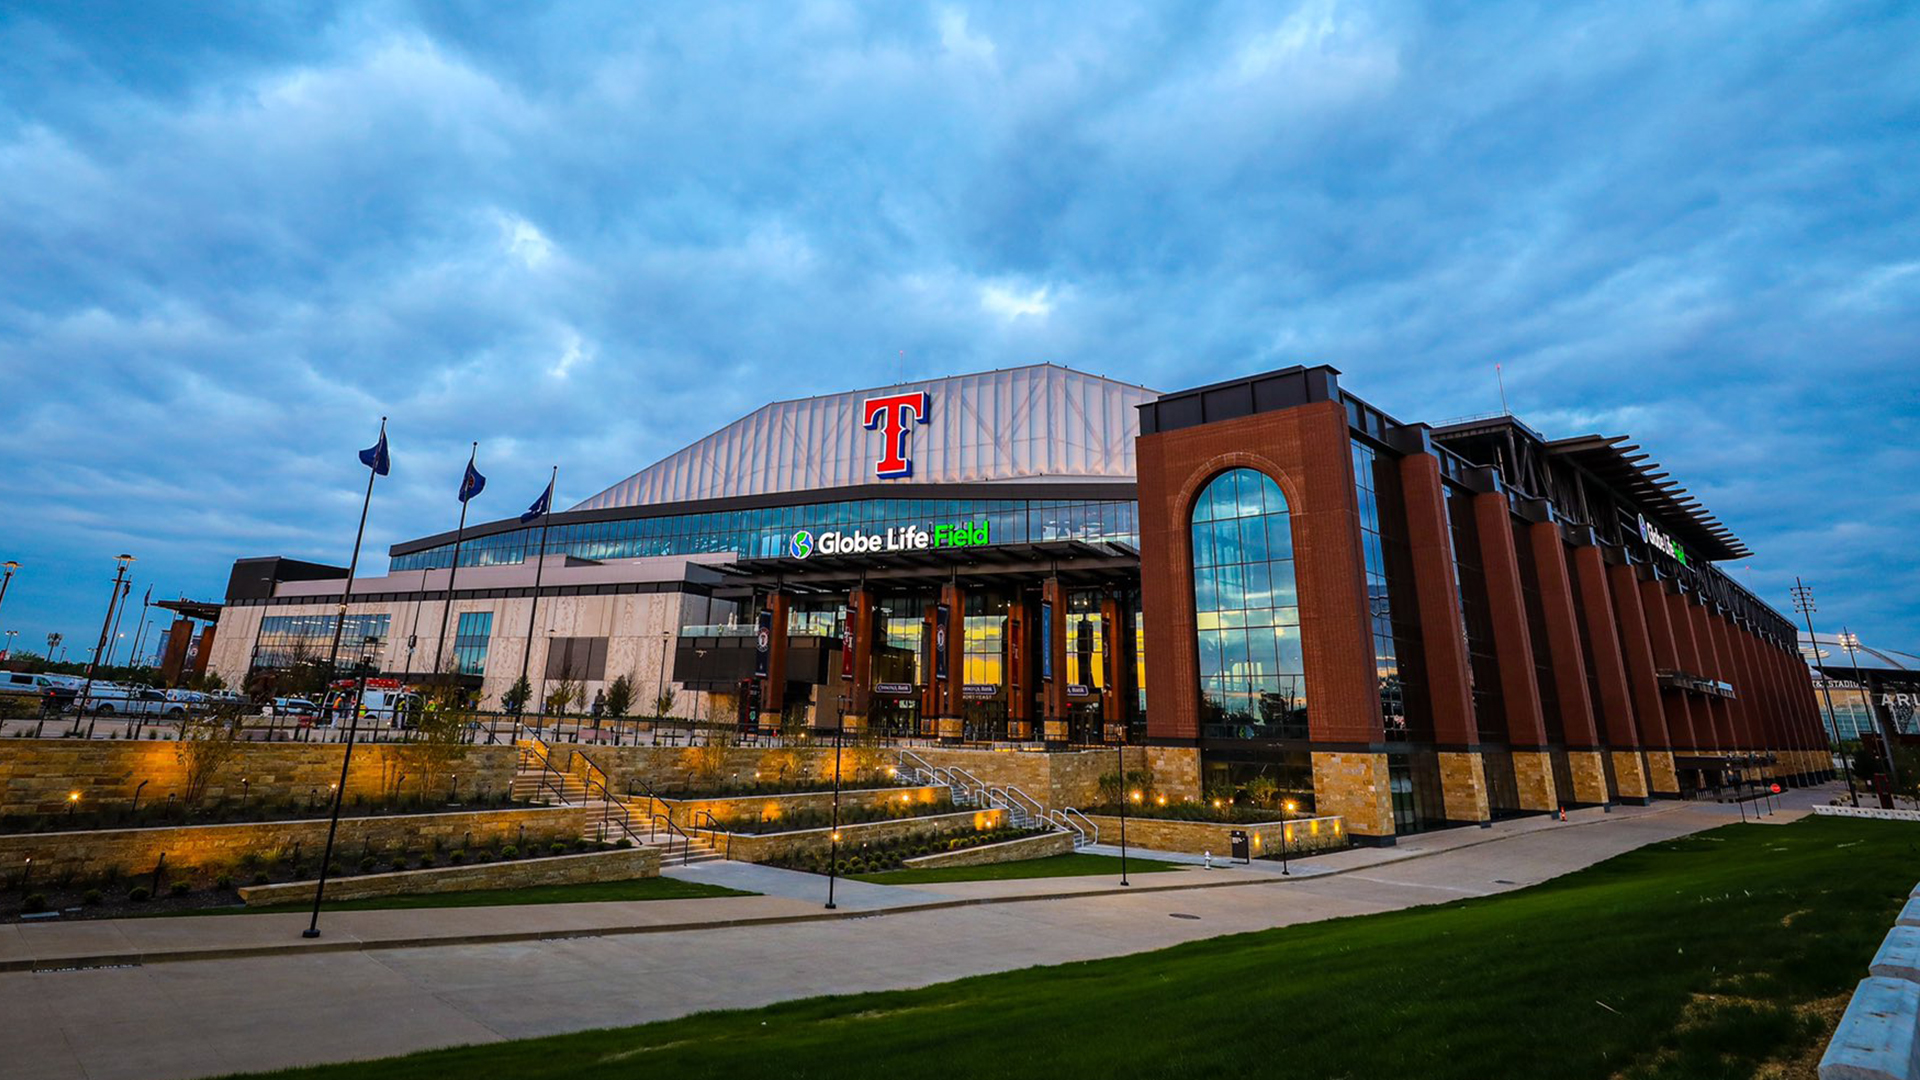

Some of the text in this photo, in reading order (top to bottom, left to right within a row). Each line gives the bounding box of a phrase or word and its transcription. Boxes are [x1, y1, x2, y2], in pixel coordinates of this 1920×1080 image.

[863, 391, 930, 479] T
[818, 520, 989, 554] Globe Life Field
